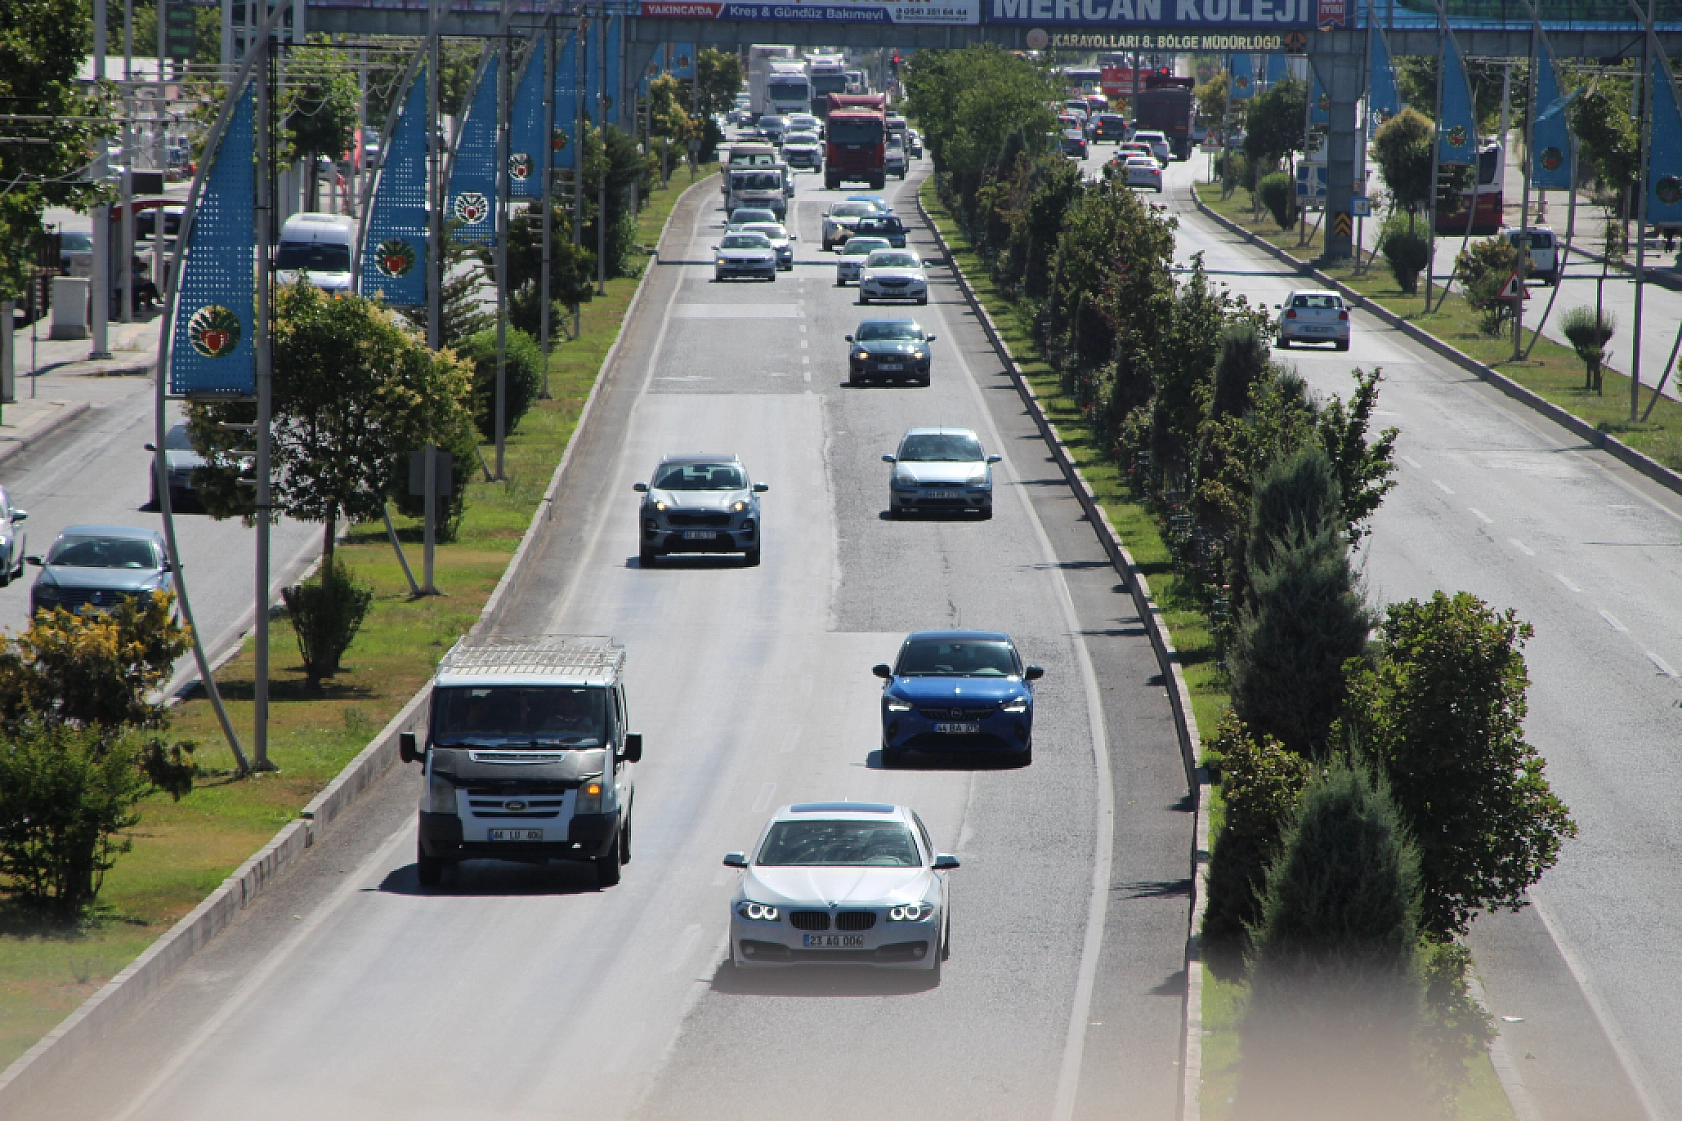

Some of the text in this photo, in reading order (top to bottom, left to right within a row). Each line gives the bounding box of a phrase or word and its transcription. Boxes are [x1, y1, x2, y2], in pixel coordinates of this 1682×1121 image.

[730, 6, 884, 20] Kreş & Gündüz Bakımevi
[993, 0, 1161, 20] MERCAN
[1052, 33, 1138, 48] KARAYOLLARI
[1142, 35, 1154, 48] 8.
[1157, 33, 1199, 49] BÖLGE
